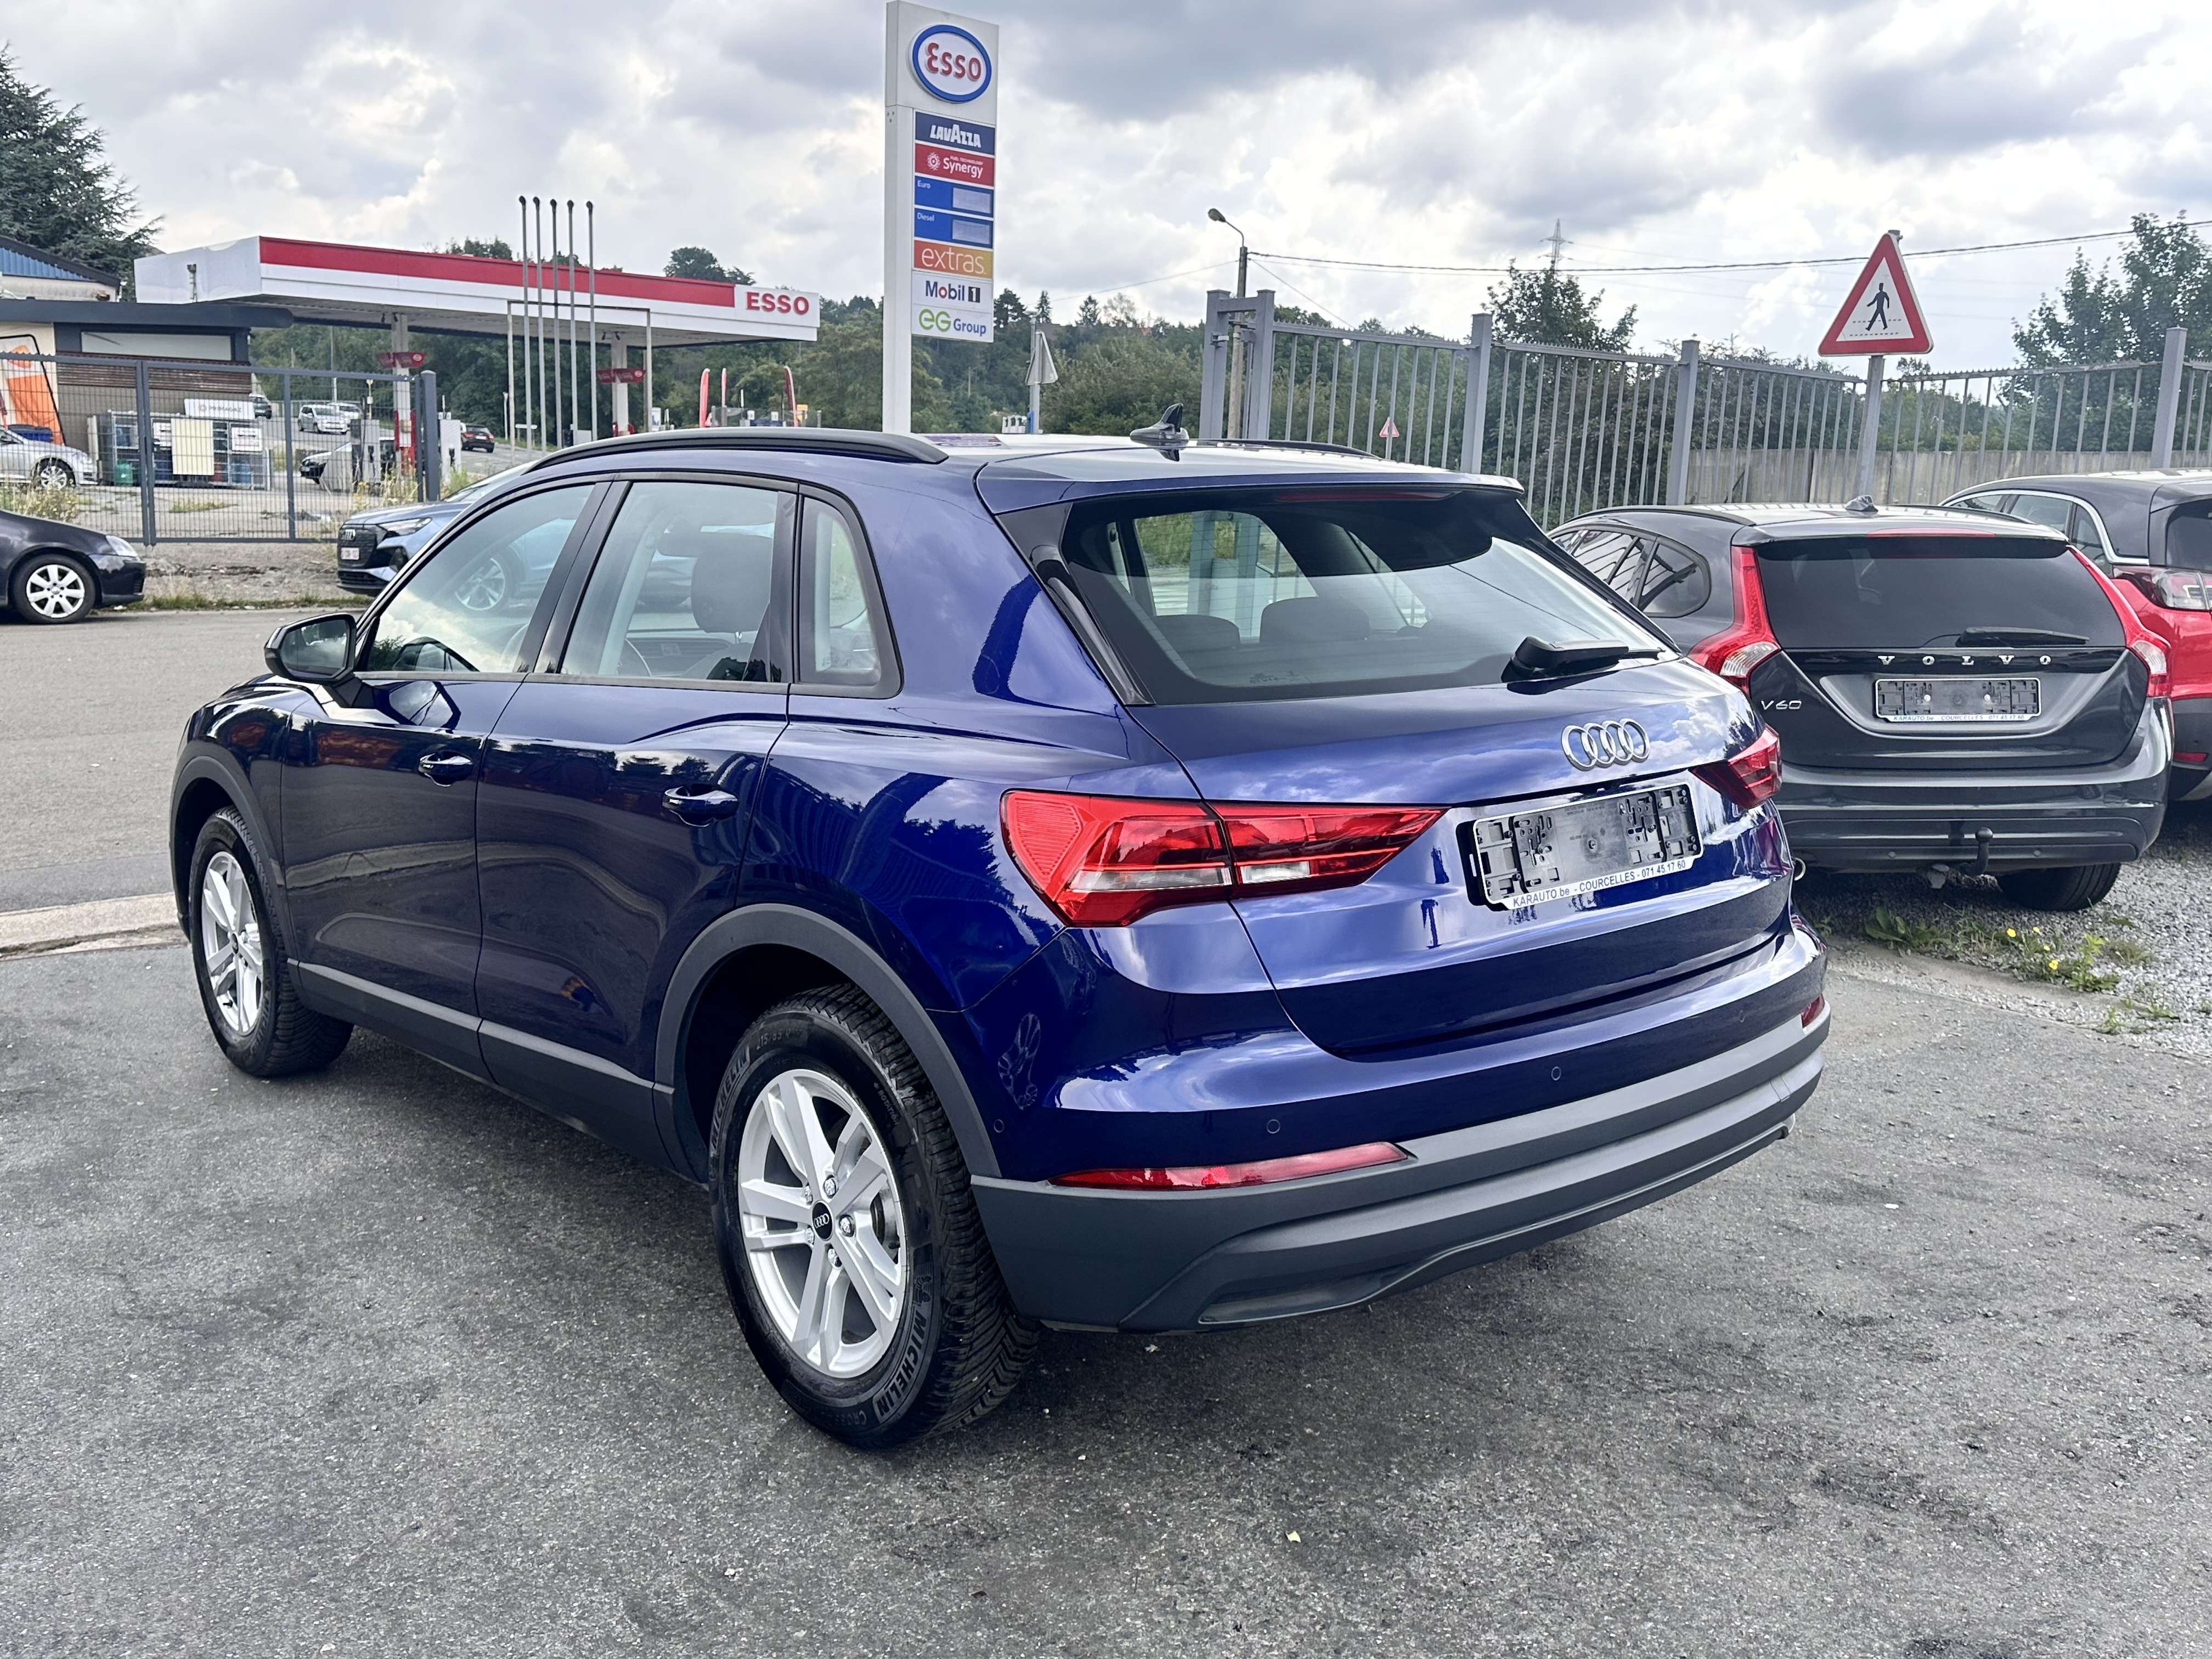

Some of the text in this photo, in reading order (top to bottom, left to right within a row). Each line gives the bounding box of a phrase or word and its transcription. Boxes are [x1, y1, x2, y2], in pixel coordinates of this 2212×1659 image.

[930, 124, 981, 148] LAVAZZA
[943, 157, 984, 179] Synergy
[917, 180, 931, 189] Euro
[917, 212, 935, 222] Diesel
[921, 247, 985, 274] extras
[926, 280, 965, 301] Mobil
[746, 291, 809, 315] ESSO
[953, 318, 987, 337] Group
[1877, 655, 2052, 665] VOLVO
[1760, 699, 1802, 710] V60
[1579, 871, 1635, 893] COURCELLES
[875, 1310, 927, 1418] MICHELIN
